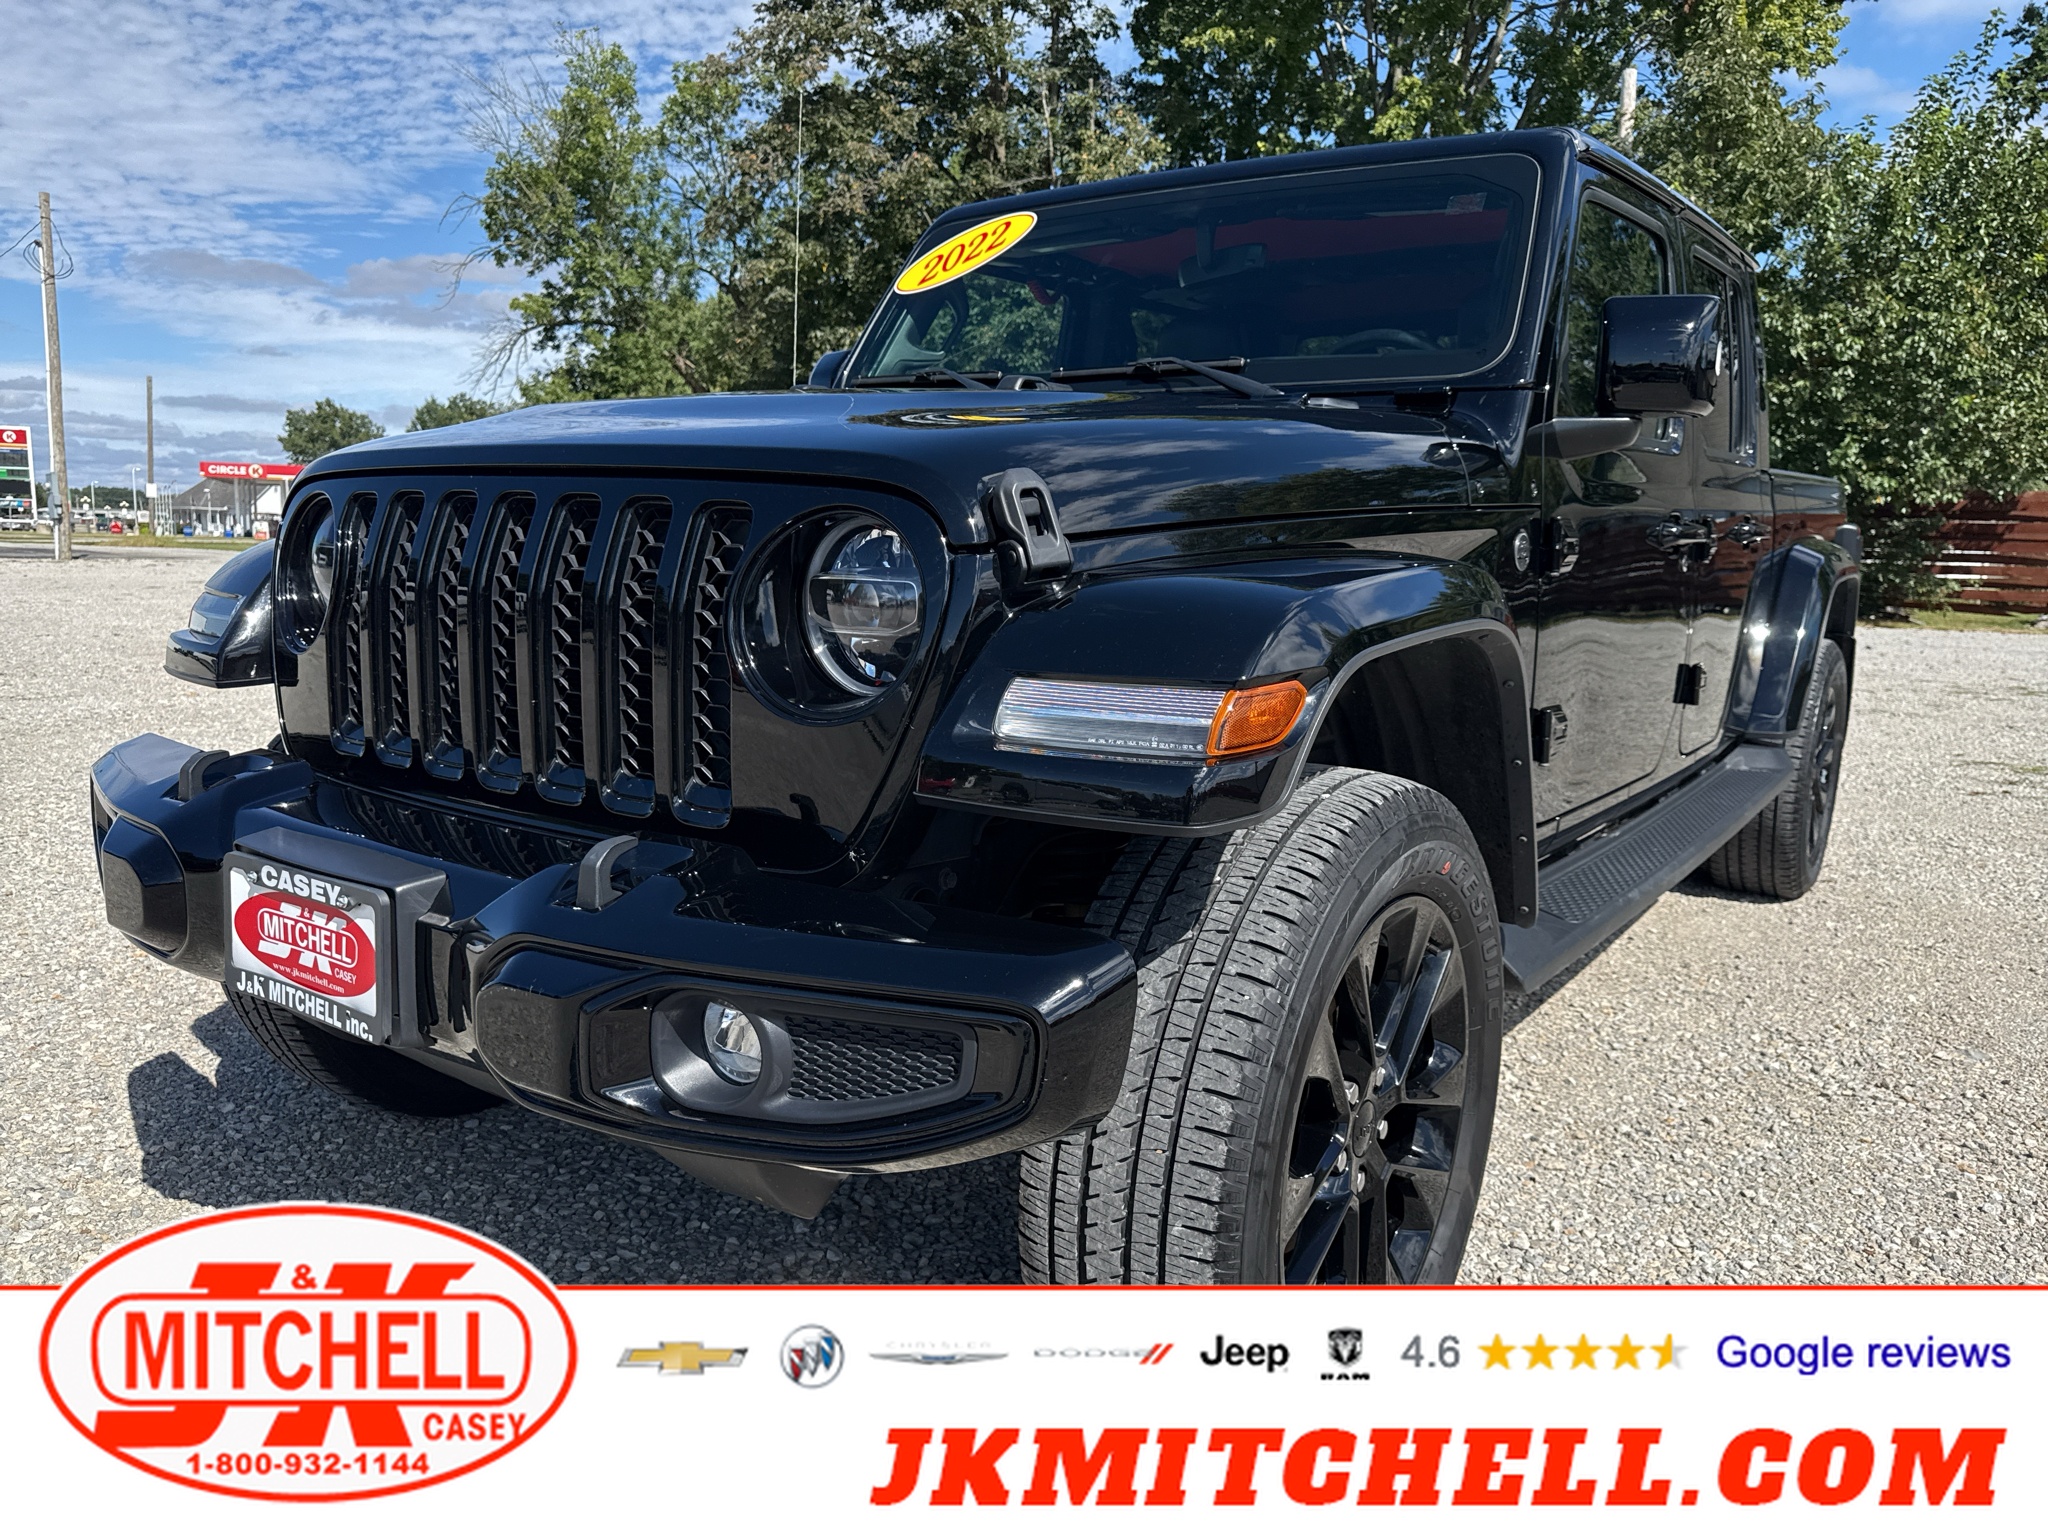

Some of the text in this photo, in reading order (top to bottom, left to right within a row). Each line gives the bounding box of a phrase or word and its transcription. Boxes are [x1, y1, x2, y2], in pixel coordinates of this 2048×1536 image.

[917, 221, 1012, 287] 2022
[208, 464, 247, 475] CIRCLE
[261, 865, 341, 907] CASEY
[264, 913, 352, 963] MITCHELL
[273, 962, 345, 993] www.jkmitchell.com
[334, 967, 357, 985] CASEY
[237, 971, 265, 998] J&K
[269, 980, 342, 1029] MITCHELL
